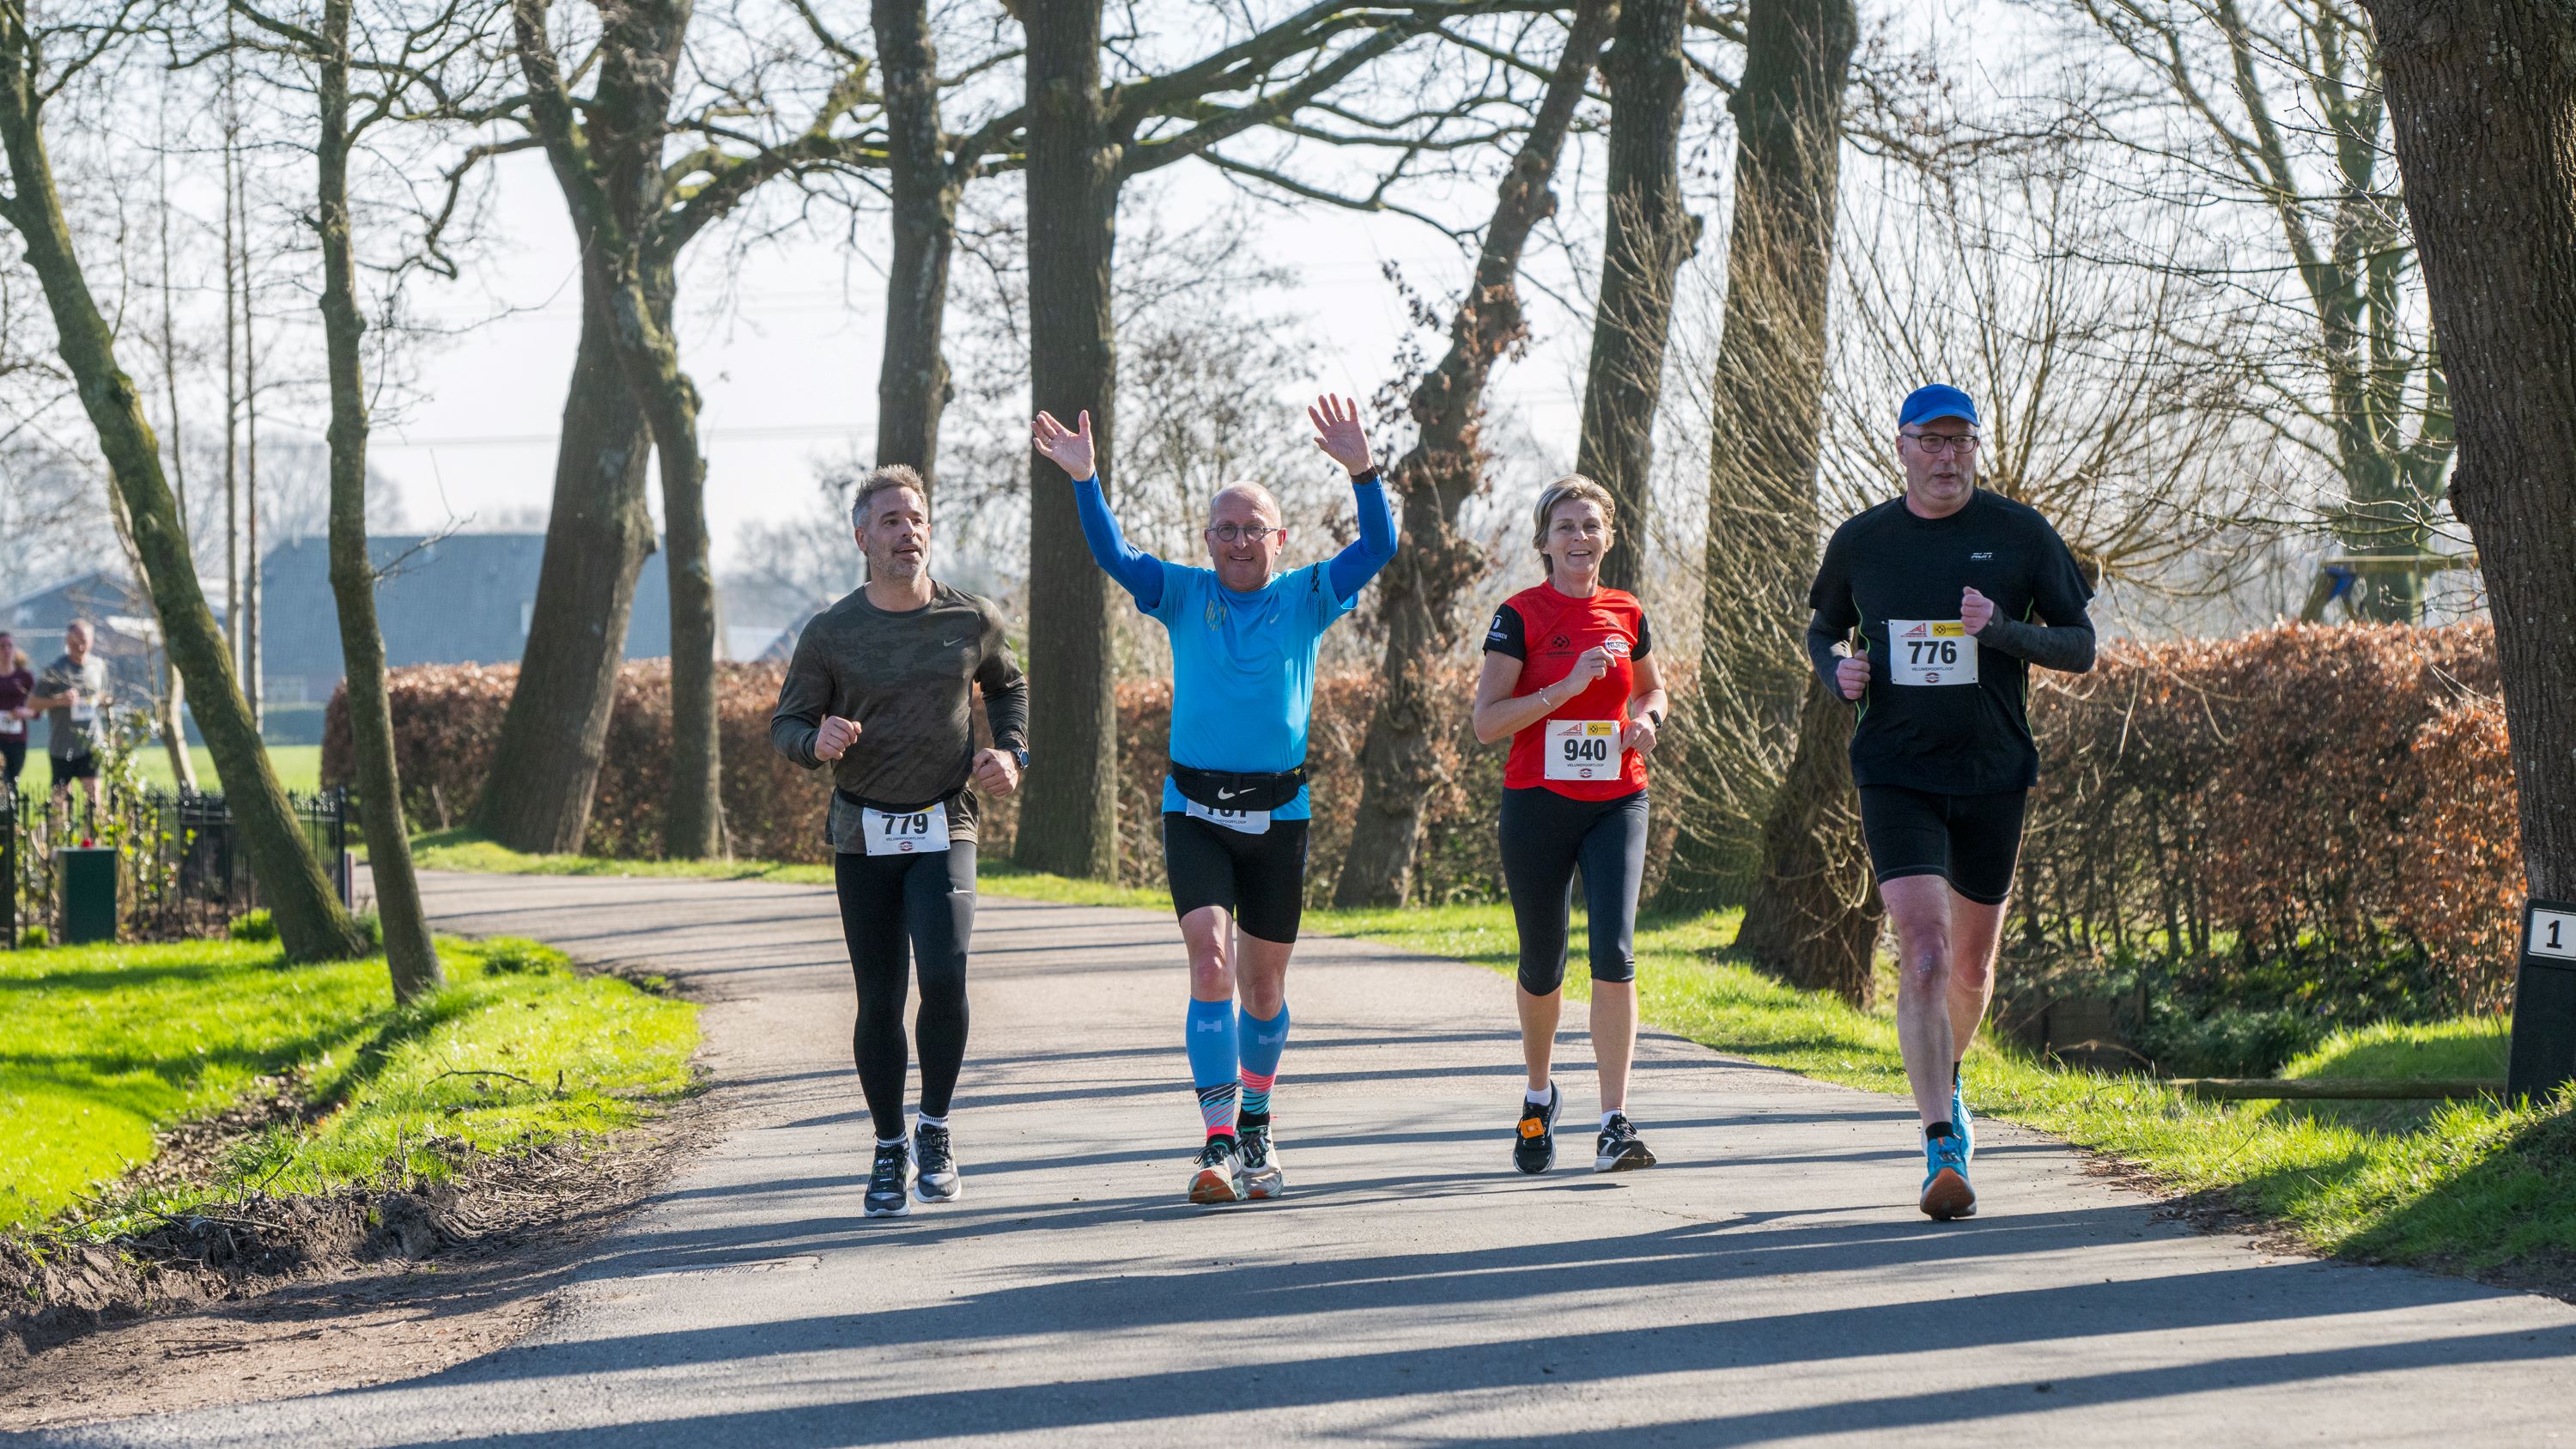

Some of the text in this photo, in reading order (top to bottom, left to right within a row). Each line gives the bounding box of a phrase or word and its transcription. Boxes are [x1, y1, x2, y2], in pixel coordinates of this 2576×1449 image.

[1907, 640, 1957, 664] 776
[1564, 739, 1607, 761] 940
[881, 813, 928, 835] 779
[2546, 919, 2563, 949] 1
